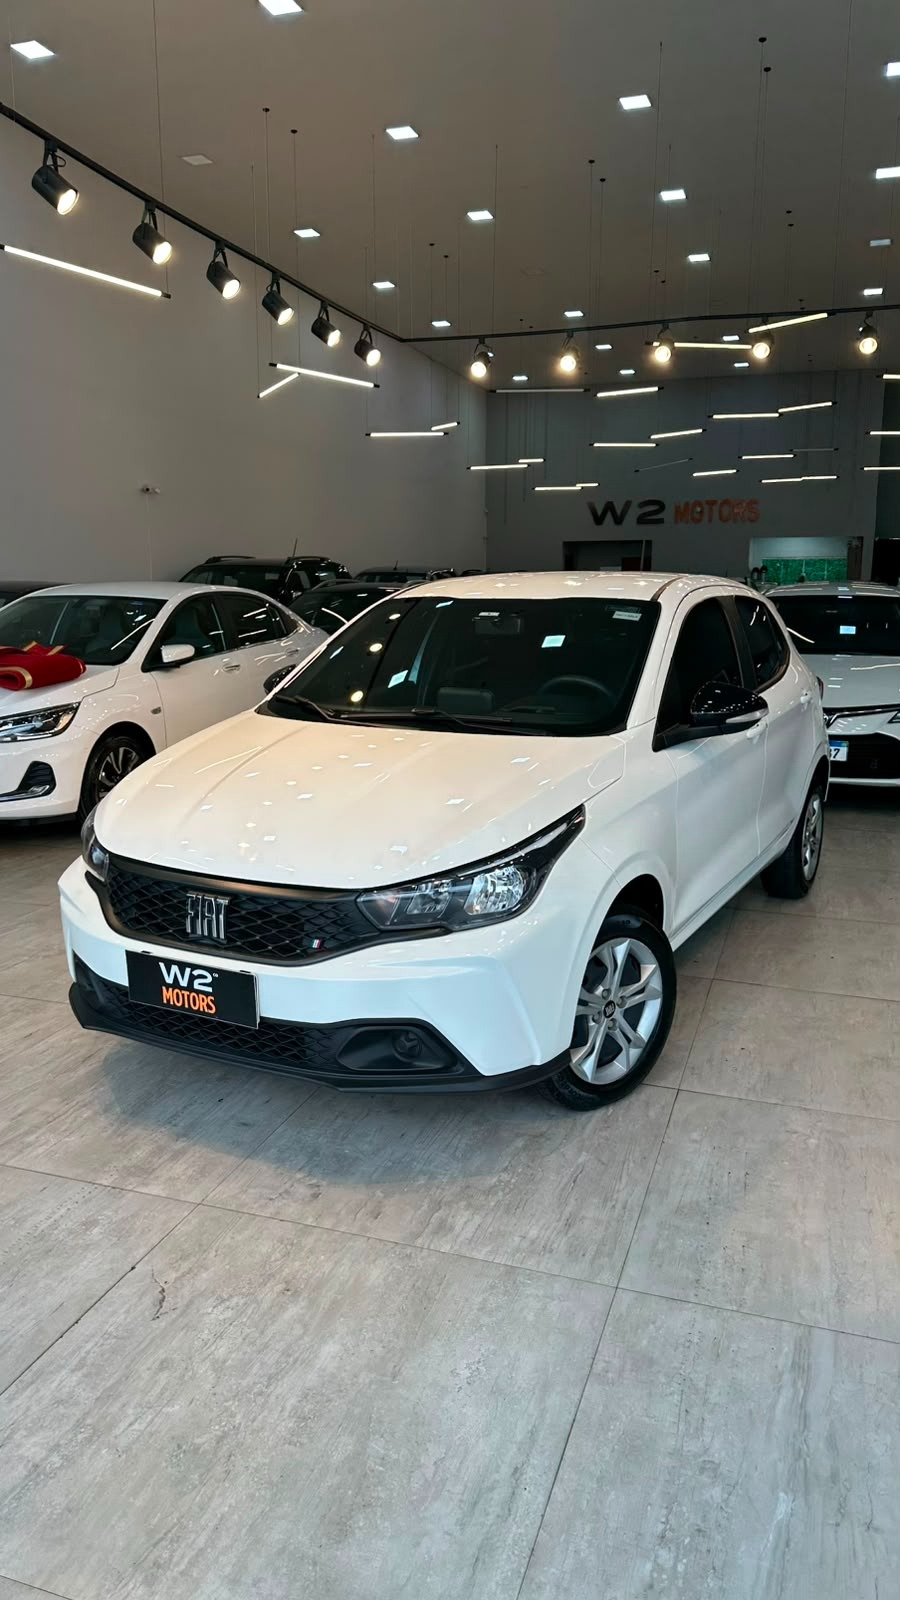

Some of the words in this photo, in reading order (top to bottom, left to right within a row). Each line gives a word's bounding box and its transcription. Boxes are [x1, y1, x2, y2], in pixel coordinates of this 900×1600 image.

[587, 499, 666, 526] W2
[674, 499, 760, 525] MOTORS
[185, 891, 230, 941] FIAT
[158, 961, 213, 993] W2
[161, 985, 217, 1015] MOTORS
